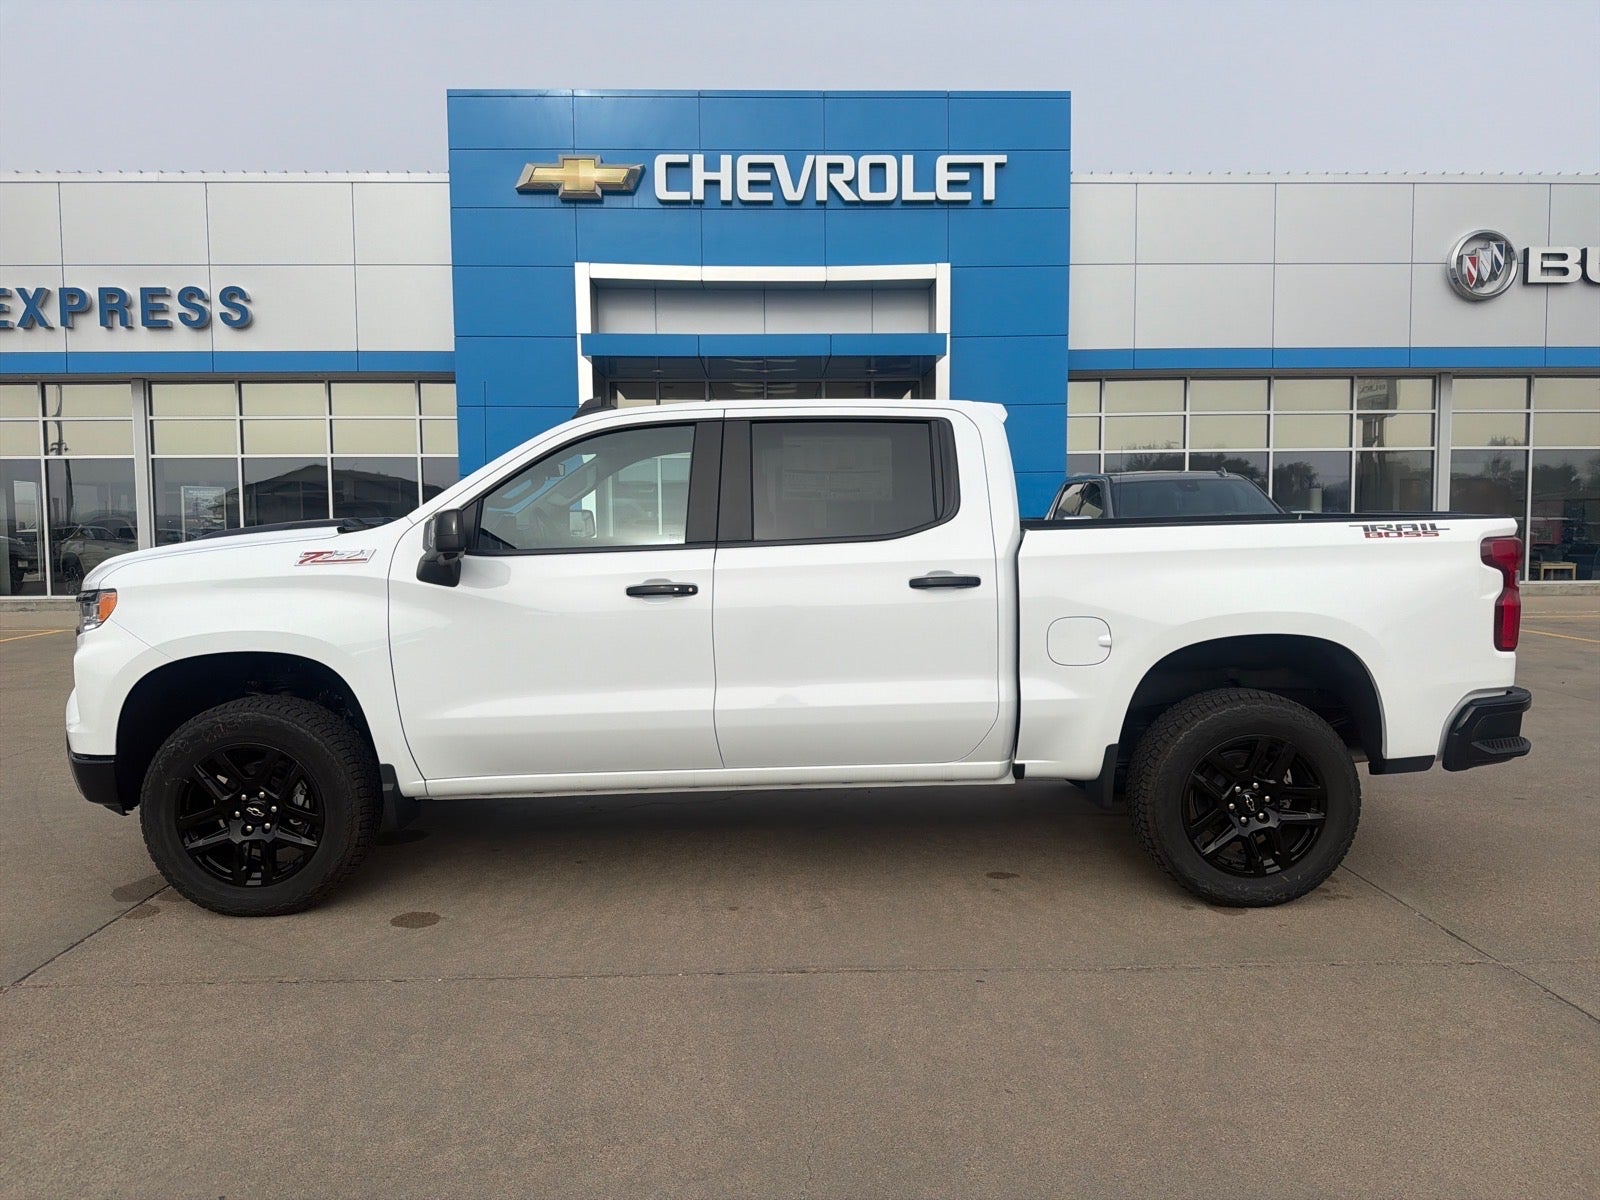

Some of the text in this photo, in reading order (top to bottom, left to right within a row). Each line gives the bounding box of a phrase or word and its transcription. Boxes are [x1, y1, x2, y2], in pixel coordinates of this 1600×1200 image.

[654, 154, 1008, 204] CHEVROLET
[1523, 246, 1600, 284] B
[1349, 523, 1450, 532] TRAIL
[1364, 531, 1440, 539] BOSS
[294, 549, 377, 567] Z71
